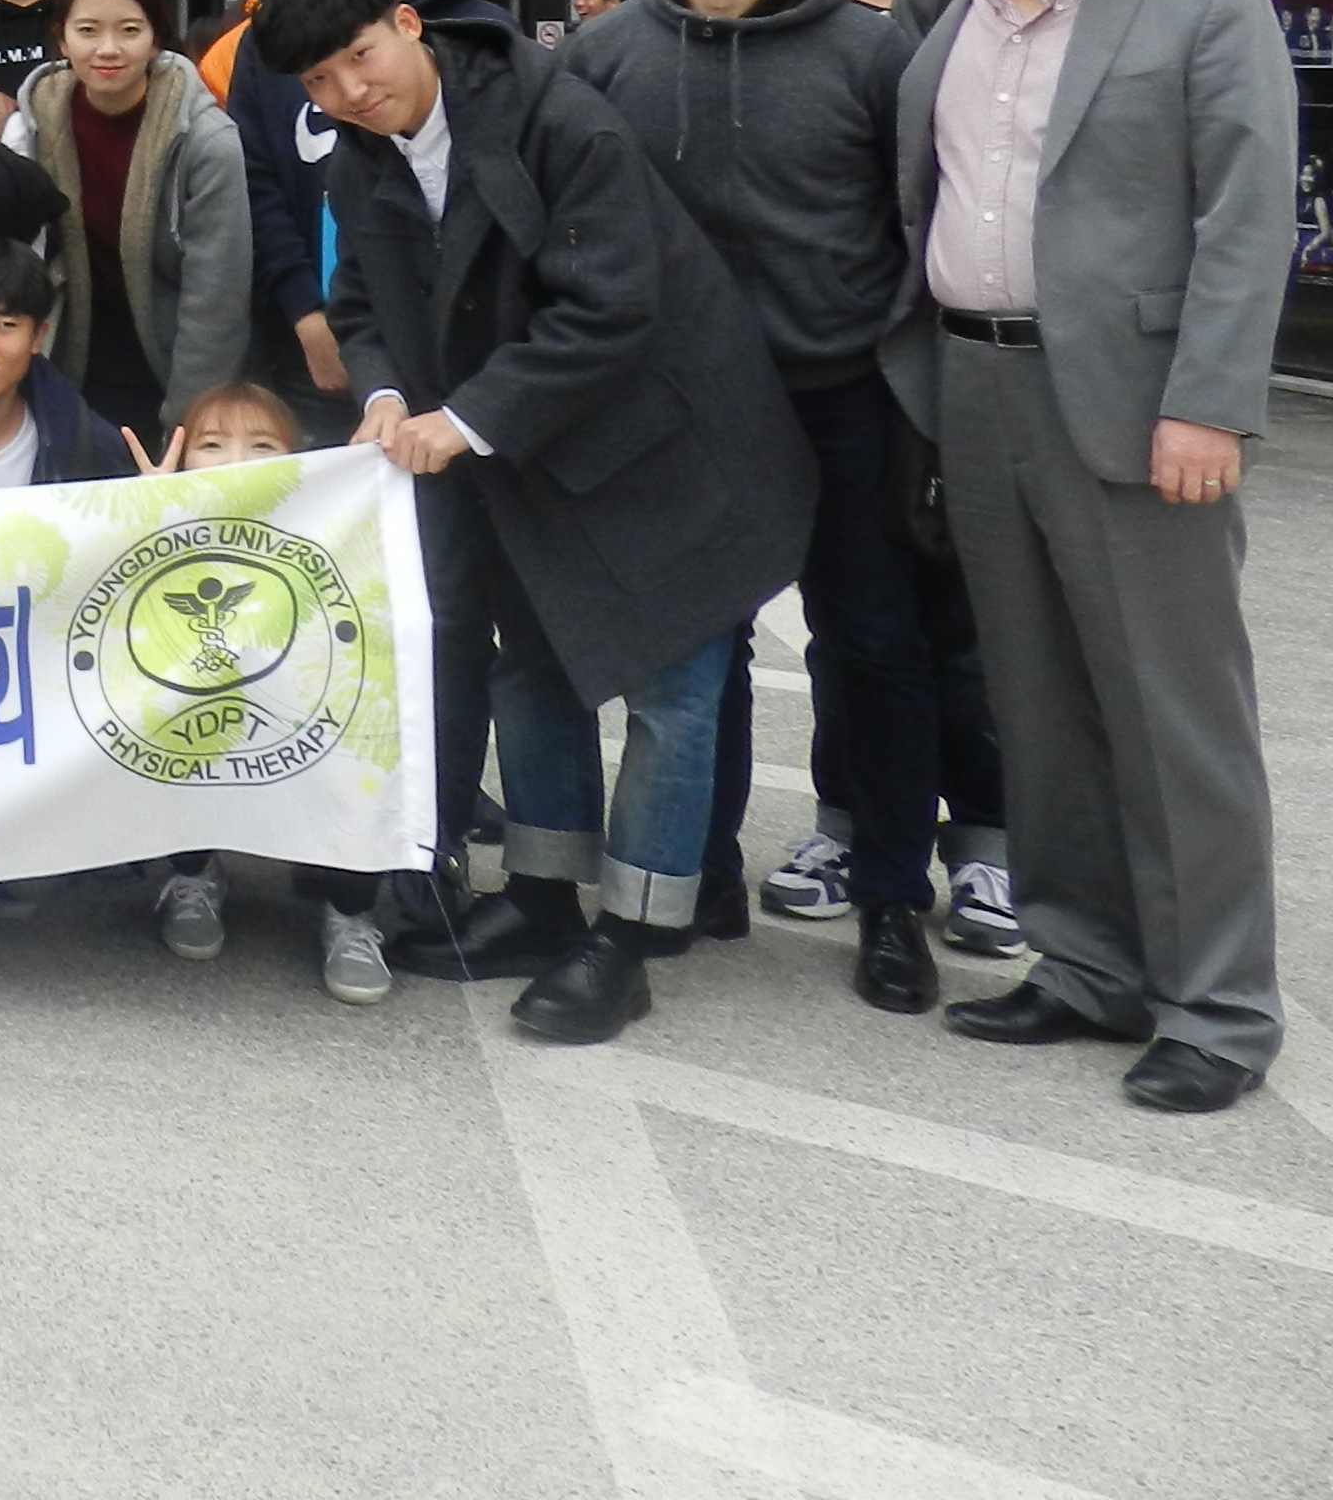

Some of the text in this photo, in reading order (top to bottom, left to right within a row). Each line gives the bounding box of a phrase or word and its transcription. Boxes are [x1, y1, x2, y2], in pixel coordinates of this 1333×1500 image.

[73, 524, 351, 642] YOUNGDONG UNIVERSITY
[95, 706, 342, 782] PHYSICAL THERAPY
[170, 706, 271, 747] YDPT
